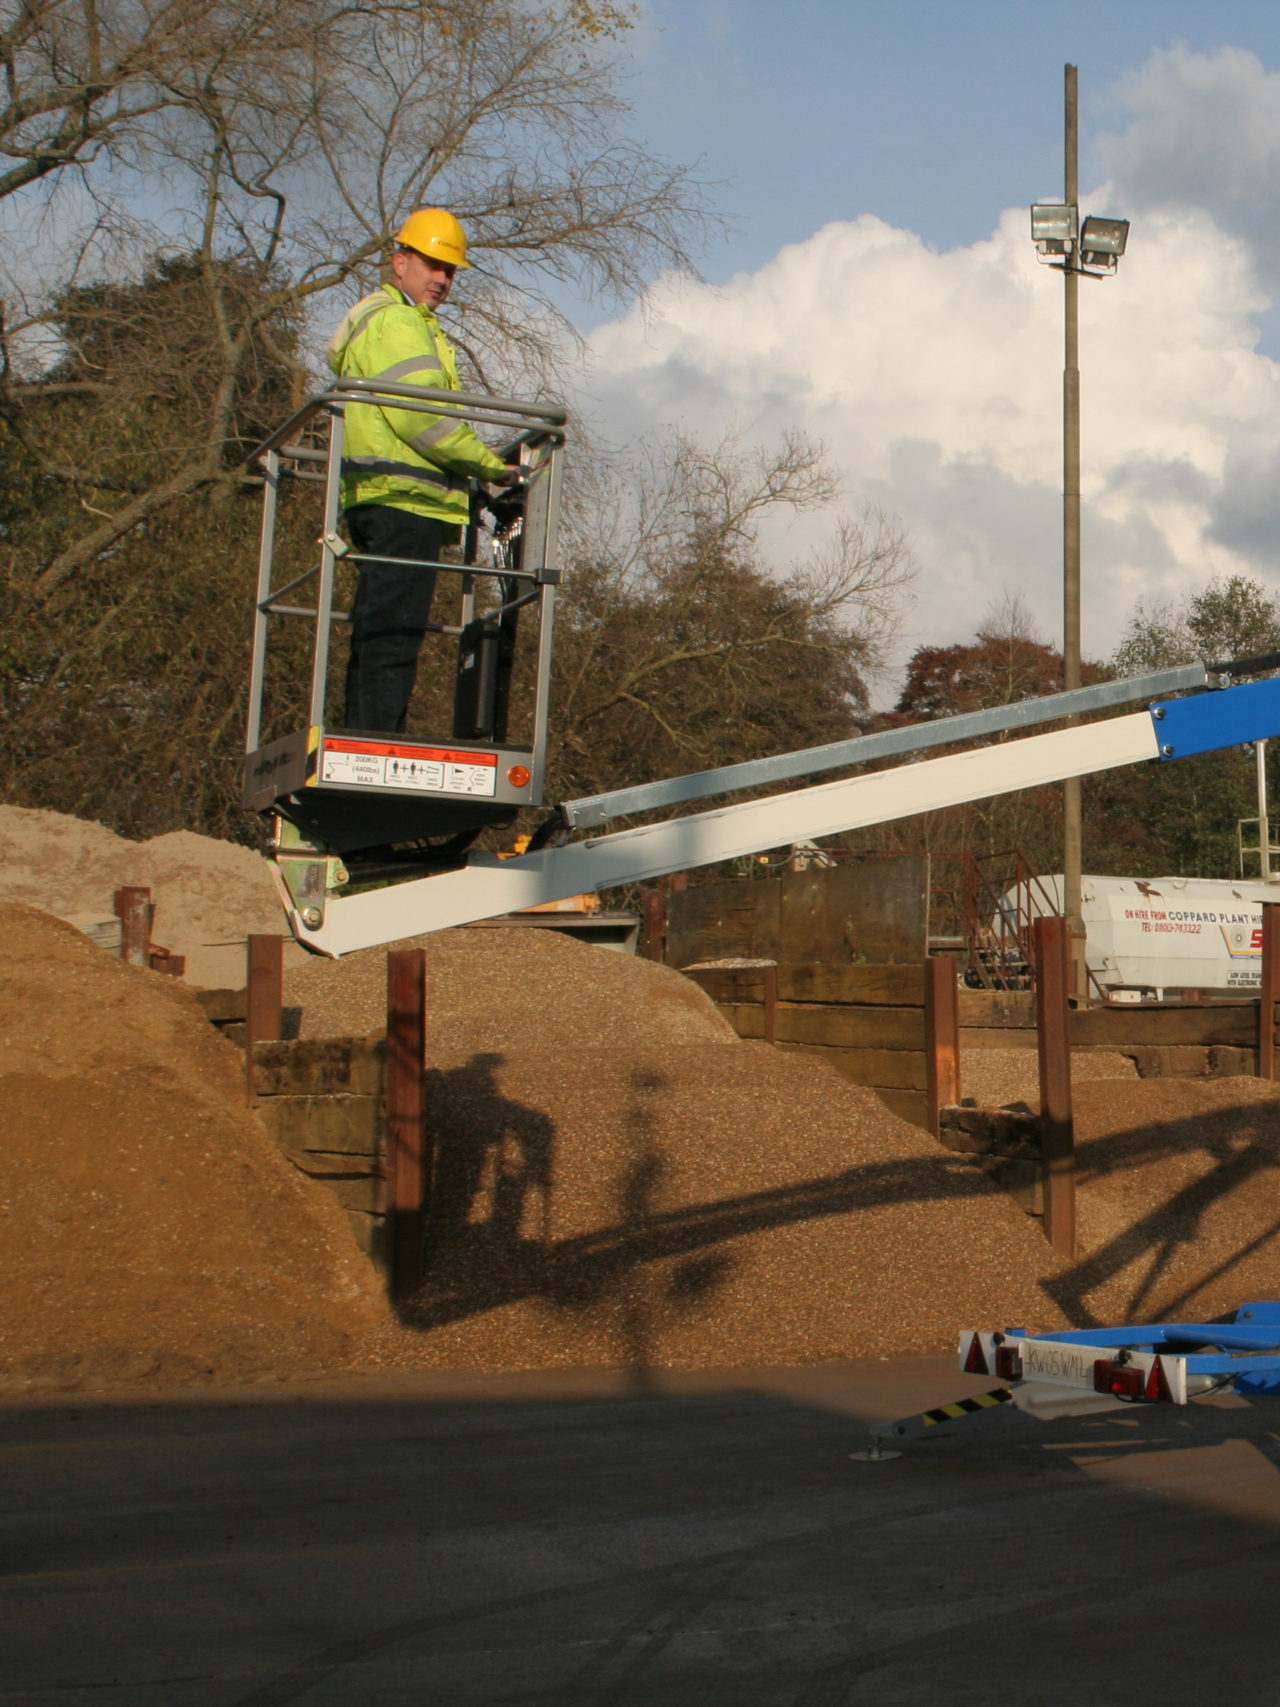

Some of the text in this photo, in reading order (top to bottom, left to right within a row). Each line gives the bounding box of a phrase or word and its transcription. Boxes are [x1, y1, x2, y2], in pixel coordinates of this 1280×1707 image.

[355, 755, 379, 764] 200KG
[356, 775, 375, 783] MAX
[1125, 909, 1134, 919] ON
[1135, 910, 1149, 920] HIRE
[1150, 910, 1167, 921] FROM
[1168, 911, 1217, 923] COPPARD
[1219, 913, 1249, 924] PLANT
